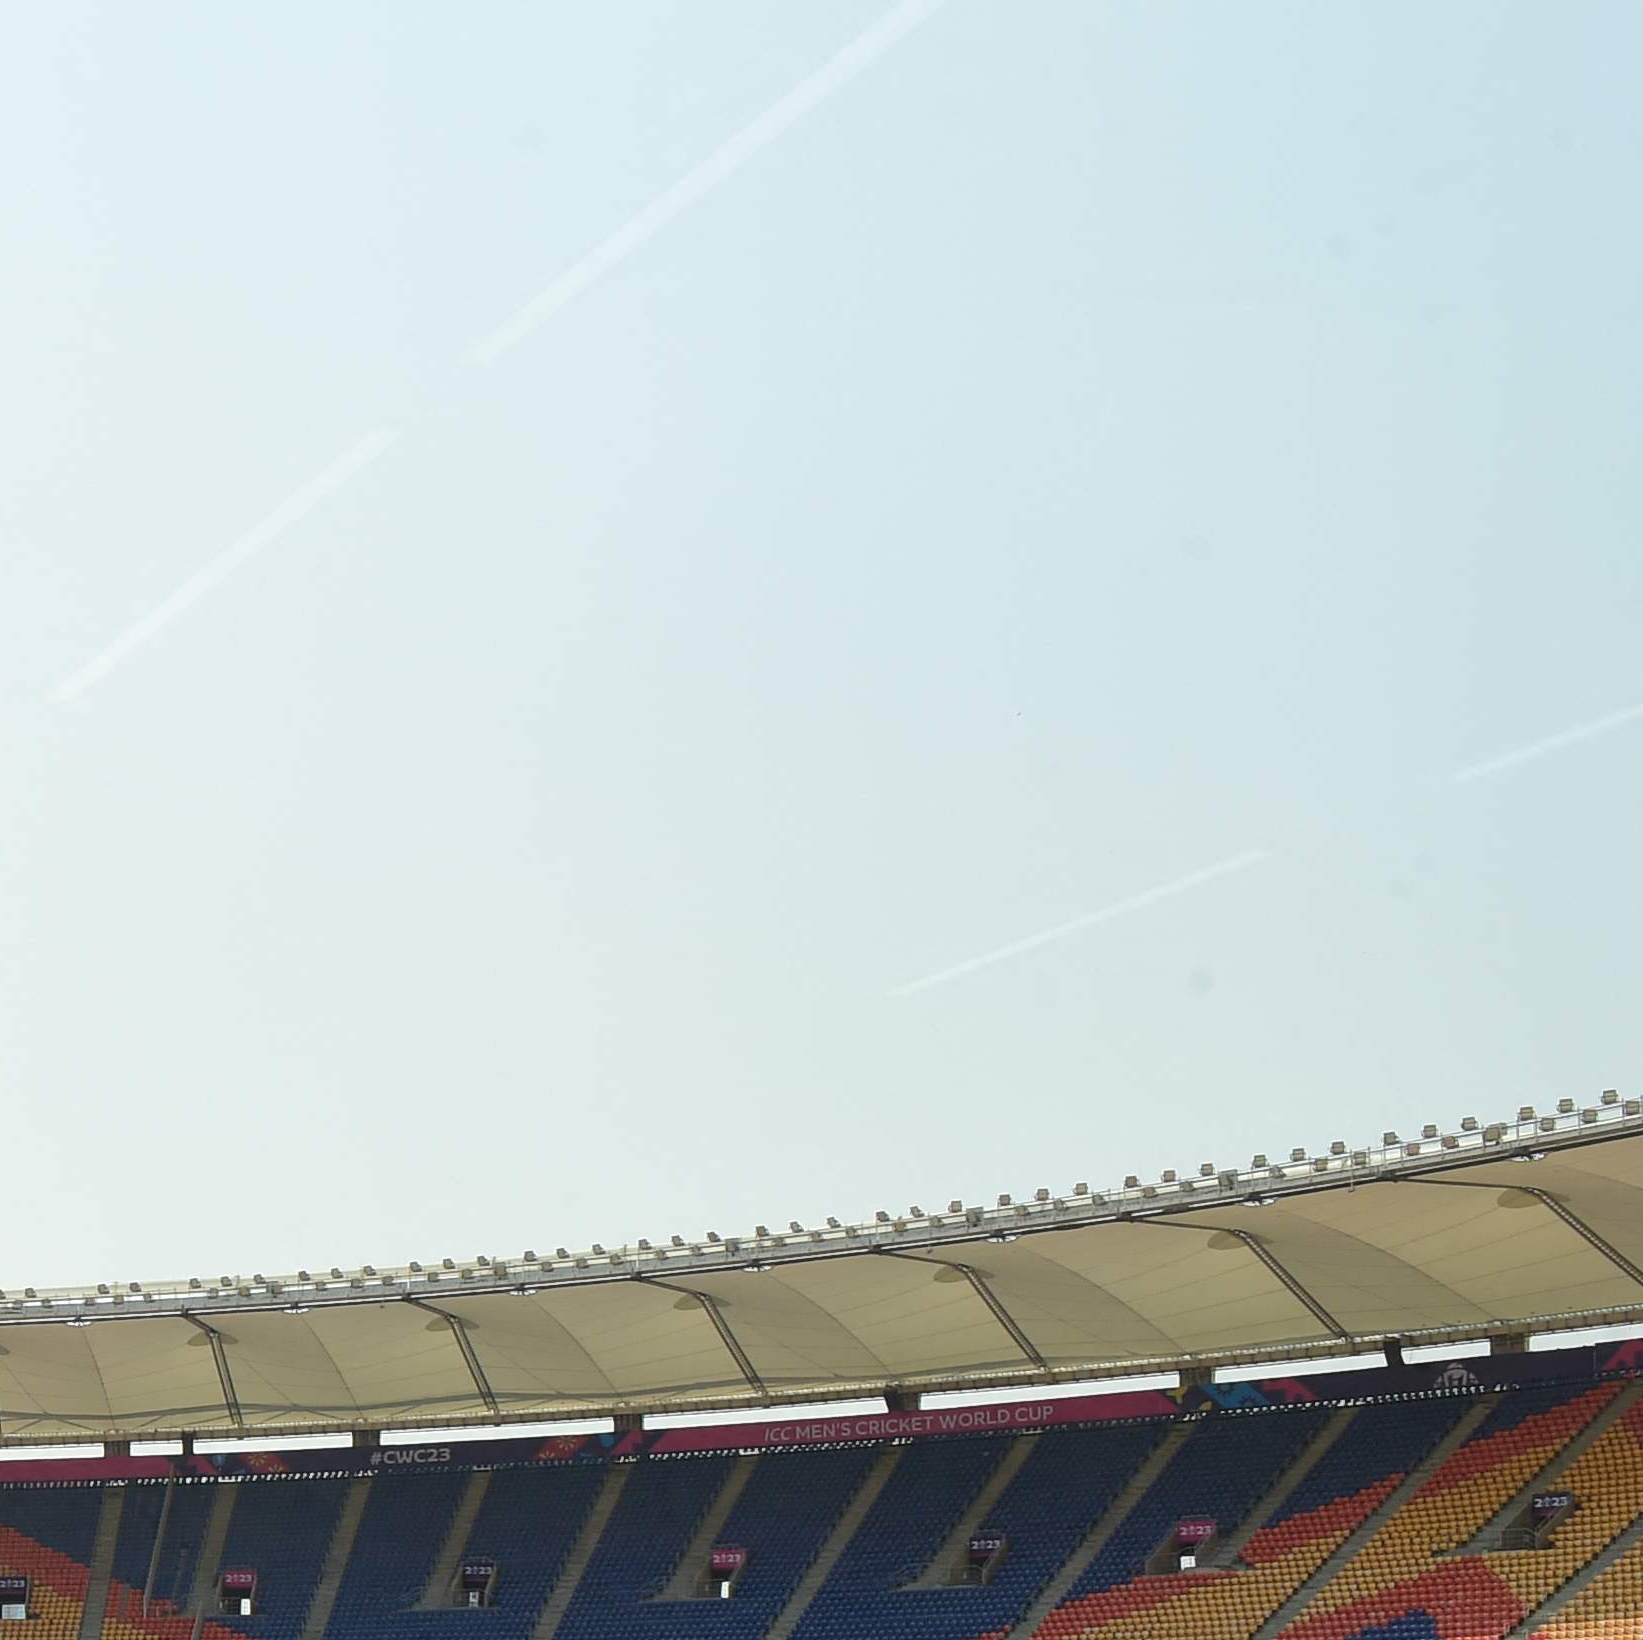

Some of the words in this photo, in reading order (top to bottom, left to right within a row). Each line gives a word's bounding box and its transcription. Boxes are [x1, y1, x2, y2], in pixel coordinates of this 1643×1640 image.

[765, 1428, 790, 1441] ICC
[795, 1422, 852, 1439] MEN'S
[855, 1416, 934, 1436] CRICKET
[939, 1410, 1011, 1429] WORLD
[1016, 1405, 1054, 1422] CUP
[370, 1448, 451, 1465] #CWC23
